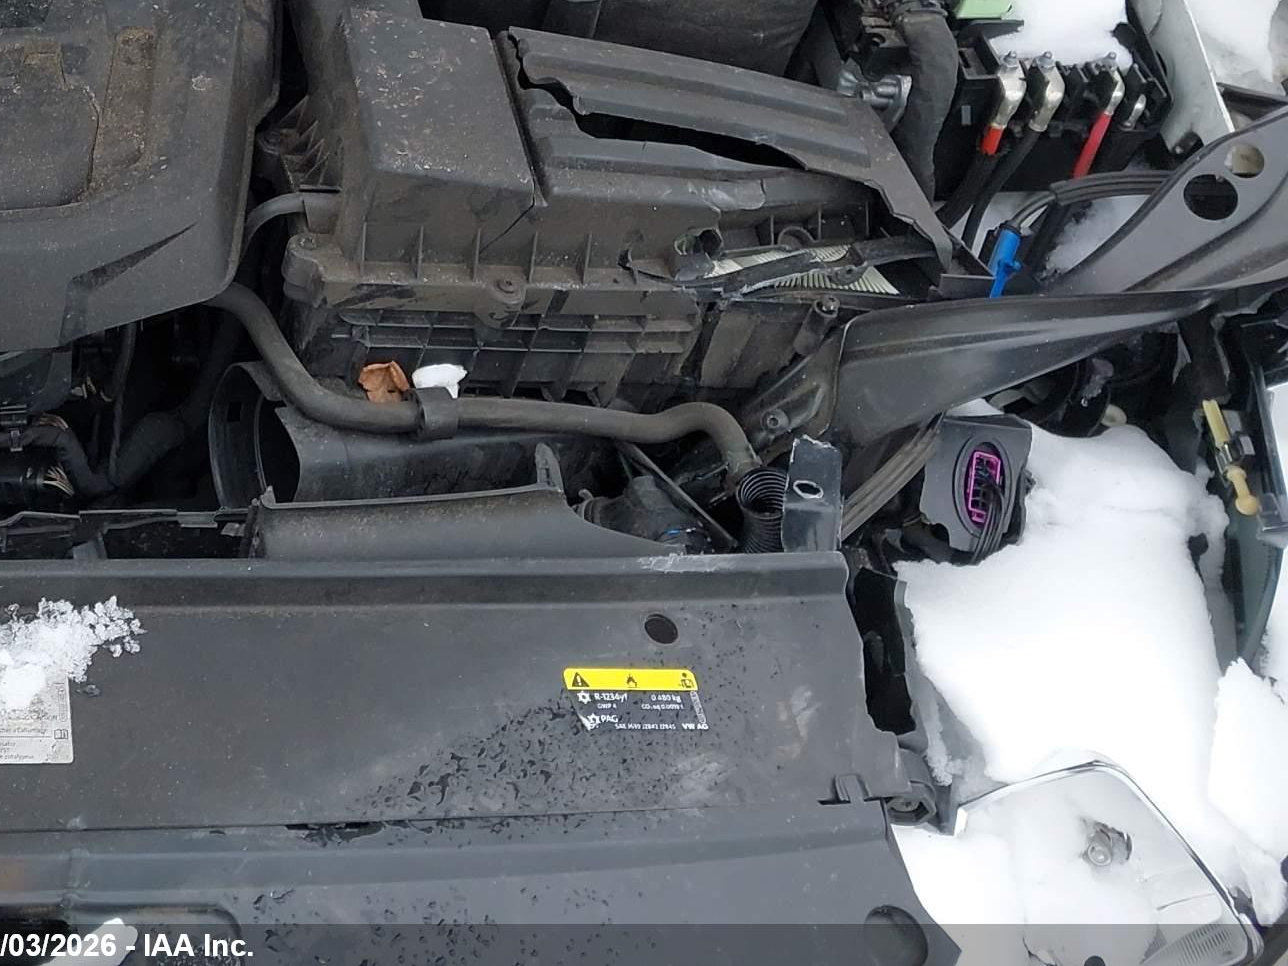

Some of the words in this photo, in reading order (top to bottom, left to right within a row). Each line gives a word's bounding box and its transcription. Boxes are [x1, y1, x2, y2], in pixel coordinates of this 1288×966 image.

[593, 692, 628, 703] R-1234yf
[672, 693, 682, 704] kg
[600, 714, 619, 723] PAG
